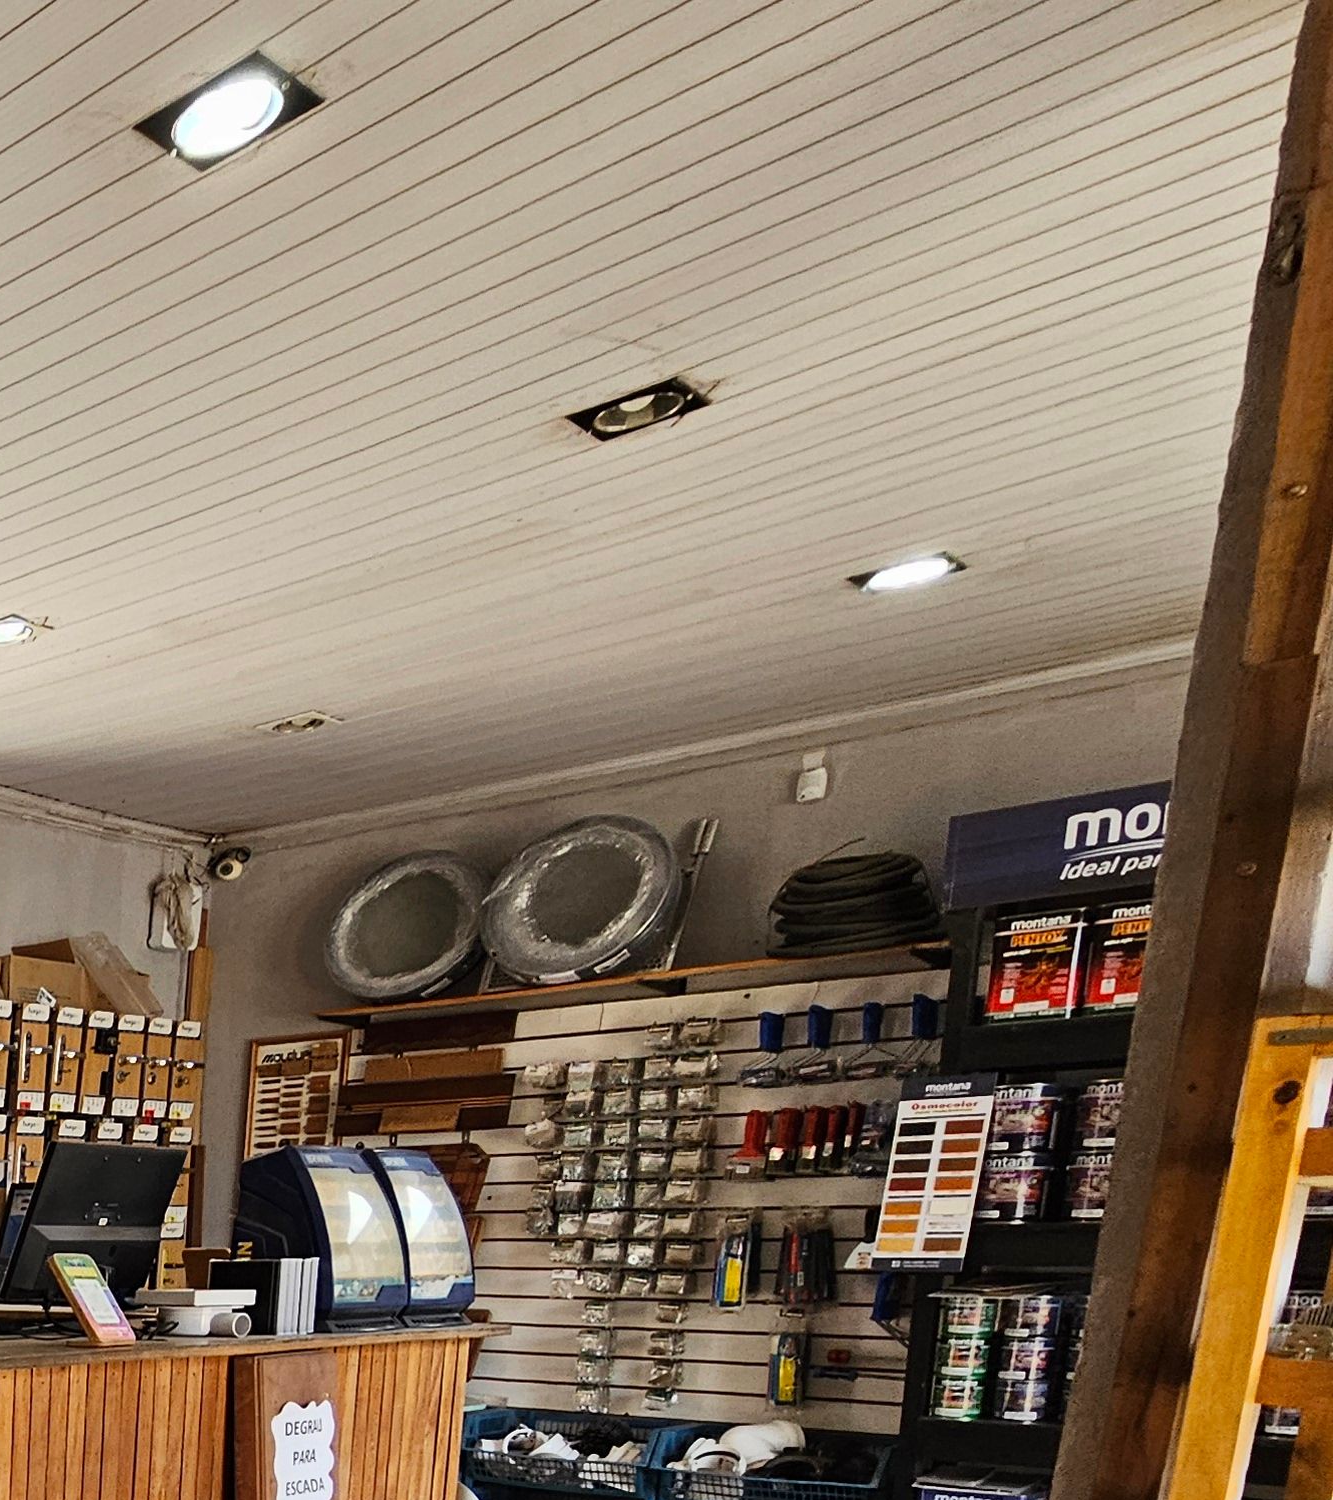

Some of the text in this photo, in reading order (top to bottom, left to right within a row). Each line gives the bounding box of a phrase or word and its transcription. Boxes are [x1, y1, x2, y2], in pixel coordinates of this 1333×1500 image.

[1059, 855, 1120, 880] Ideal
[1011, 914, 1072, 931] montana
[925, 1081, 972, 1093] montana
[285, 1418, 323, 1436] DEGRAU
[293, 1449, 316, 1465] PARA
[285, 1477, 325, 1496] ESCADA
